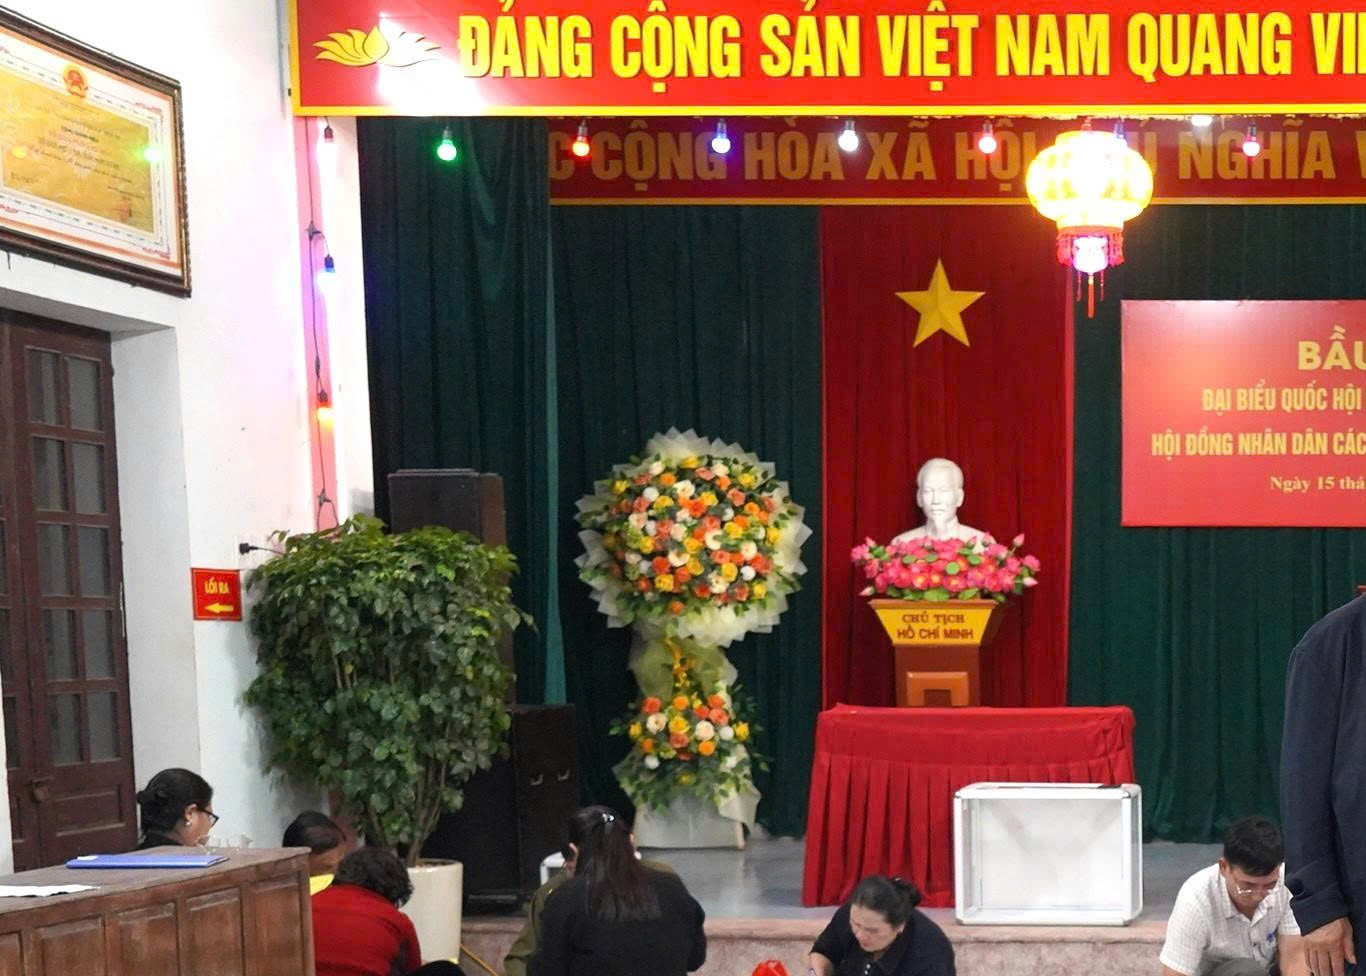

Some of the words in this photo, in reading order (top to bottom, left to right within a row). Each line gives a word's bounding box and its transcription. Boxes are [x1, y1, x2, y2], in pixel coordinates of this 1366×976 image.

[457, 0, 593, 78] ĐẢNG
[610, 0, 741, 92] CỘNG
[760, 0, 861, 77] SẢN
[877, 0, 979, 91] VIỆT
[995, 13, 1110, 76] NAM
[1127, 11, 1292, 83] QUANG
[591, 119, 728, 191] CỘNG
[744, 116, 845, 180] HÒA
[865, 119, 937, 180] XÃ
[1178, 118, 1336, 180] NGHĨA
[1202, 387, 1231, 417] ĐẠI
[1236, 379, 1277, 412] BIỂU
[1281, 379, 1328, 413] QUỐC
[1333, 383, 1362, 416] HỘI
[1152, 428, 1181, 462] HỘI
[1185, 425, 1234, 456] ĐỒNG
[1238, 427, 1288, 456] NHÂN
[1292, 427, 1328, 456] DÂN
[1270, 476, 1312, 493] Ngày
[1318, 477, 1336, 490] 15
[902, 611, 929, 624] CHỦ
[934, 613, 965, 625] TỊCH
[919, 626, 940, 639] CHÍ
[943, 629, 974, 639] MINH
